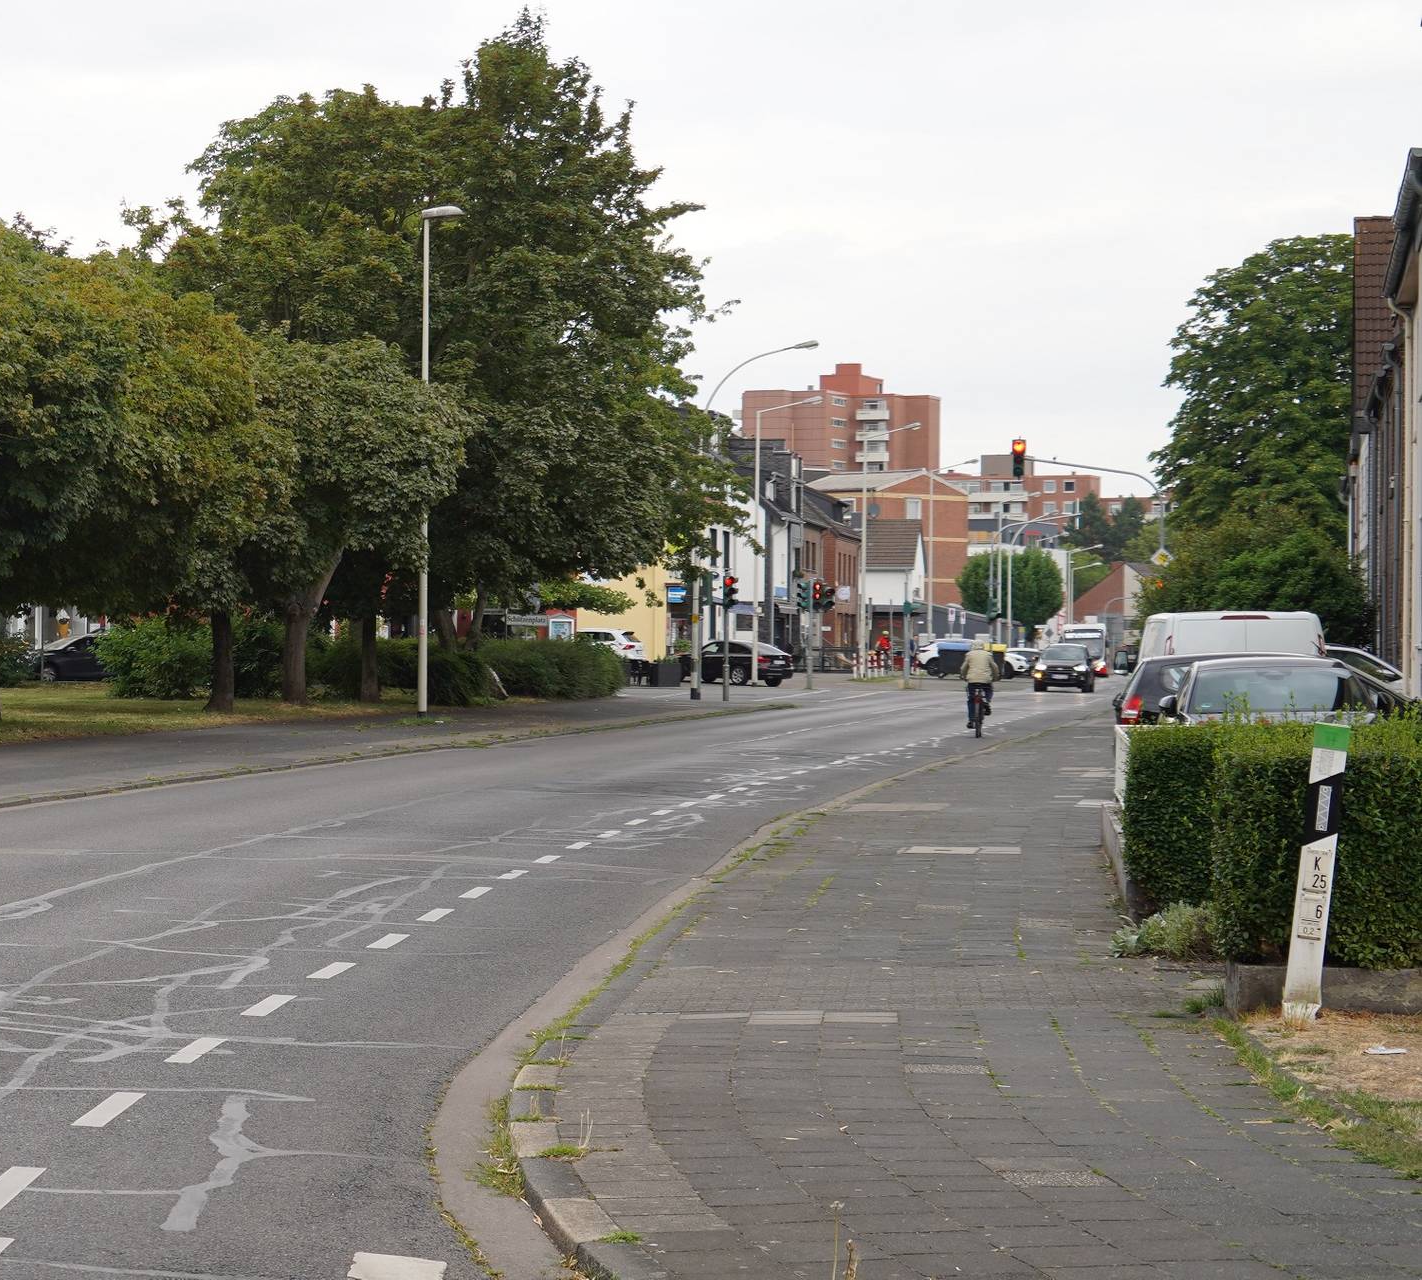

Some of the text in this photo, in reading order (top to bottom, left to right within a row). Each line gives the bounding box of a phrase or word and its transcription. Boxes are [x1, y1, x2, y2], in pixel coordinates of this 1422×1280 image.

[1314, 856, 1322, 871] K
[1312, 874, 1327, 889] 25
[1315, 904, 1323, 919] 6
